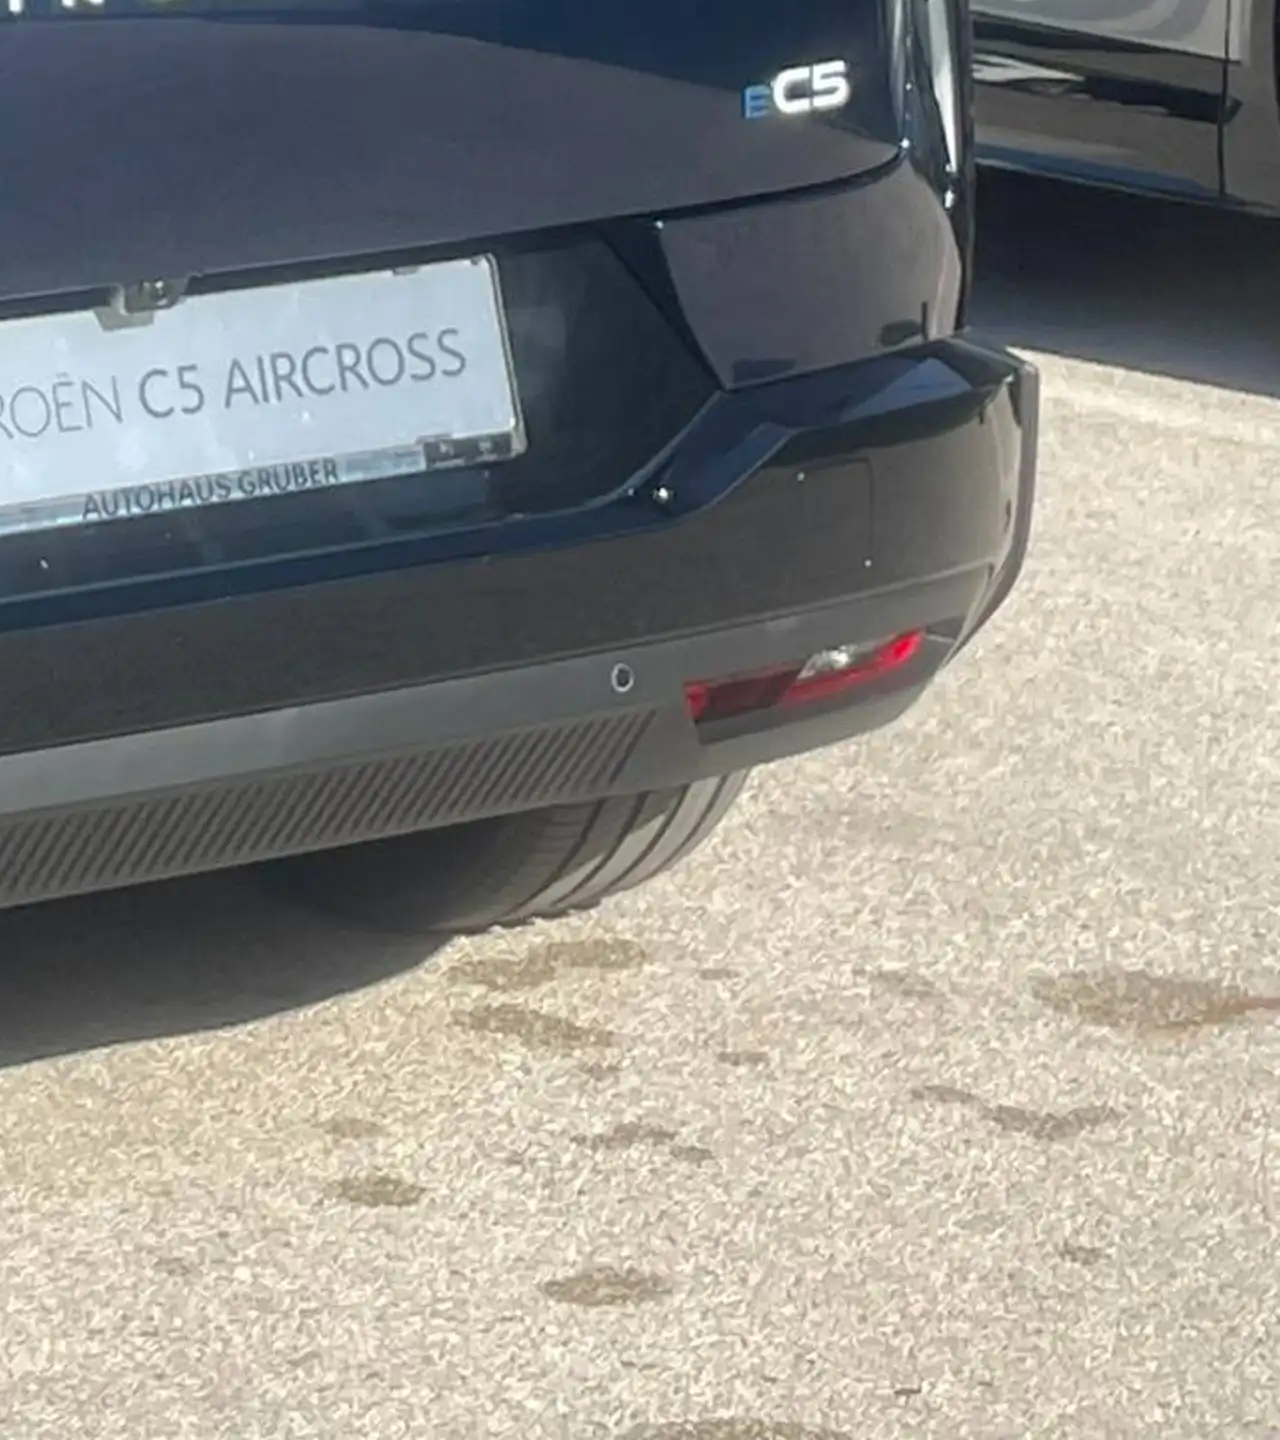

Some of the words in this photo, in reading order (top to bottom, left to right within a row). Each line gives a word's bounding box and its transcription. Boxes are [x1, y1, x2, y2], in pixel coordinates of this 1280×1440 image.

[138, 364, 205, 420] C5
[224, 327, 467, 410] AIRCROSS
[82, 474, 232, 520] AUTOHAUS
[237, 457, 339, 497] GRUBER
